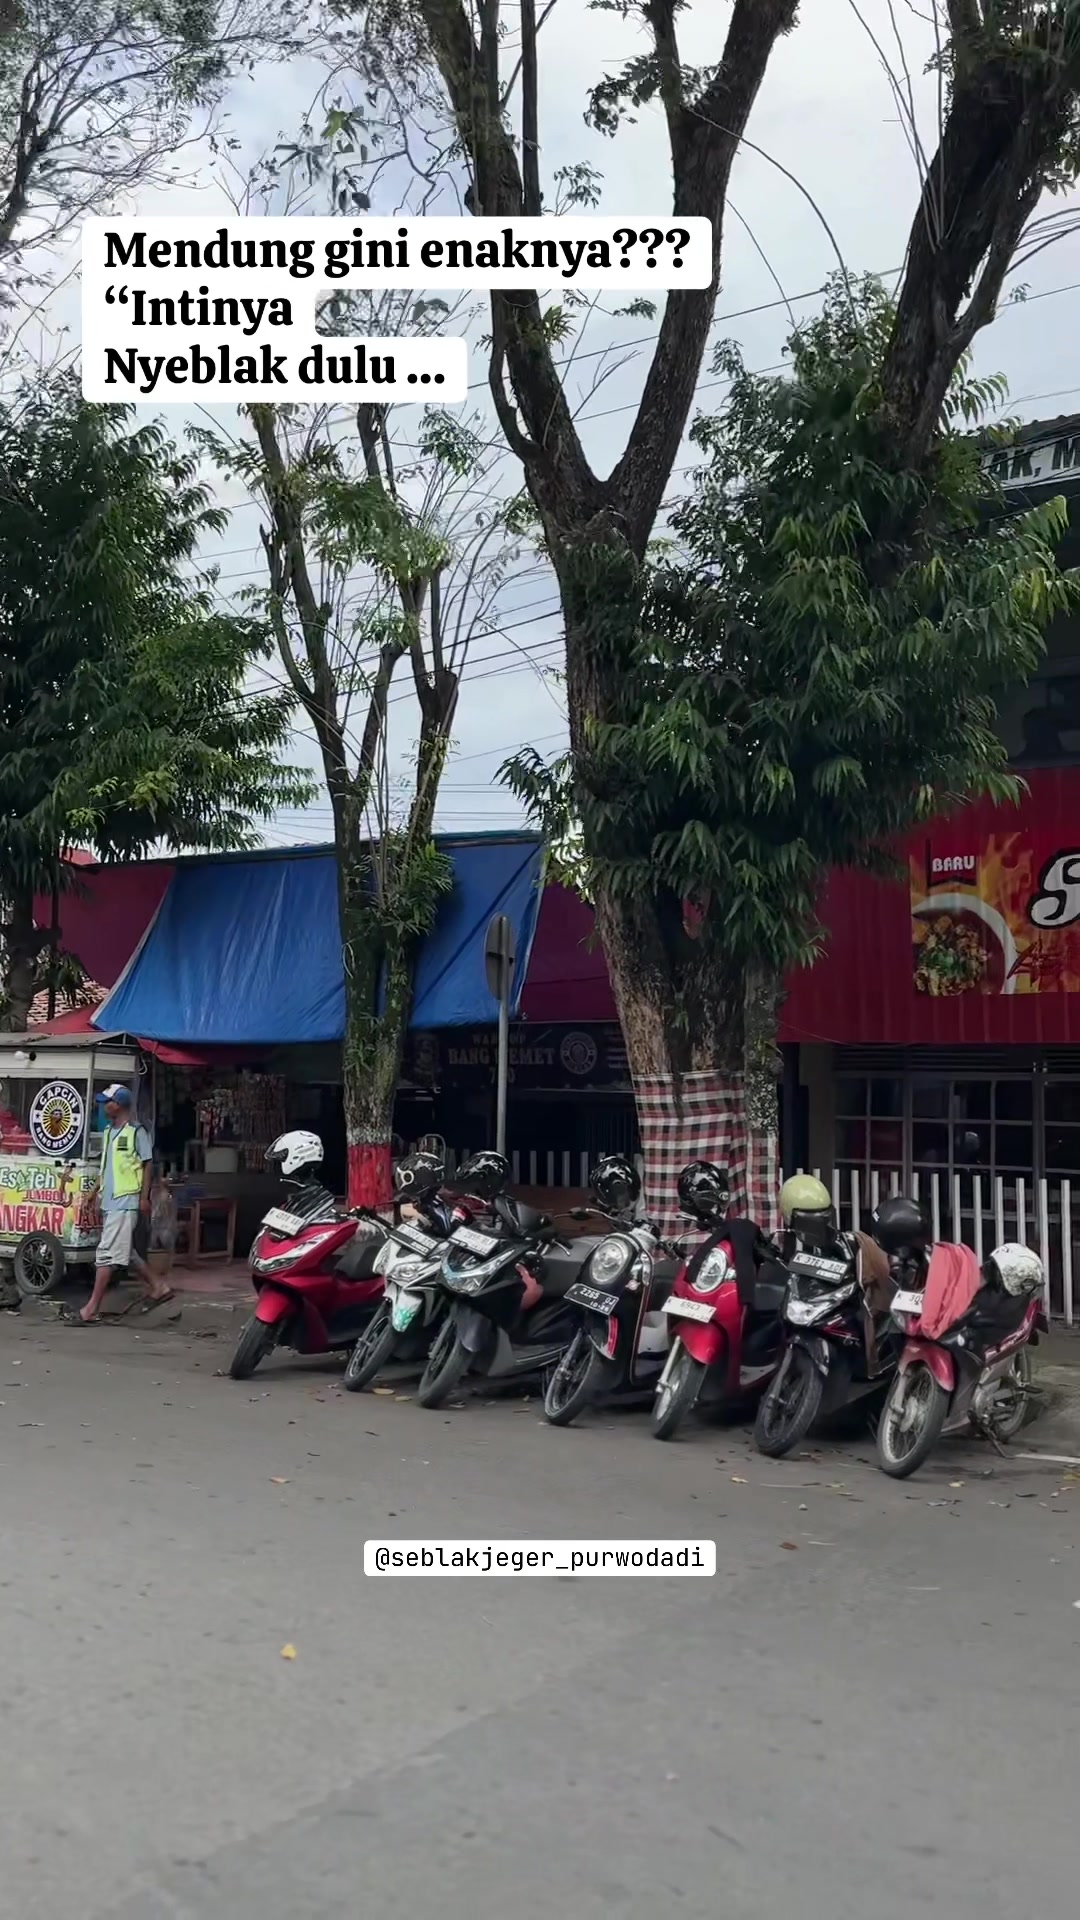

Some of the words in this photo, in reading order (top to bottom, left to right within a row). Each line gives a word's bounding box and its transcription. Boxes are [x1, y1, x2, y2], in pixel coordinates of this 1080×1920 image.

[932, 855, 975, 872] BARU
[448, 1047, 490, 1065] BANG
[39, 1086, 78, 1109] CAPCIN
[35, 1127, 52, 1149] BANG
[52, 1128, 76, 1149] MEMET
[0, 1167, 17, 1188] Es
[26, 1167, 56, 1189] Teh
